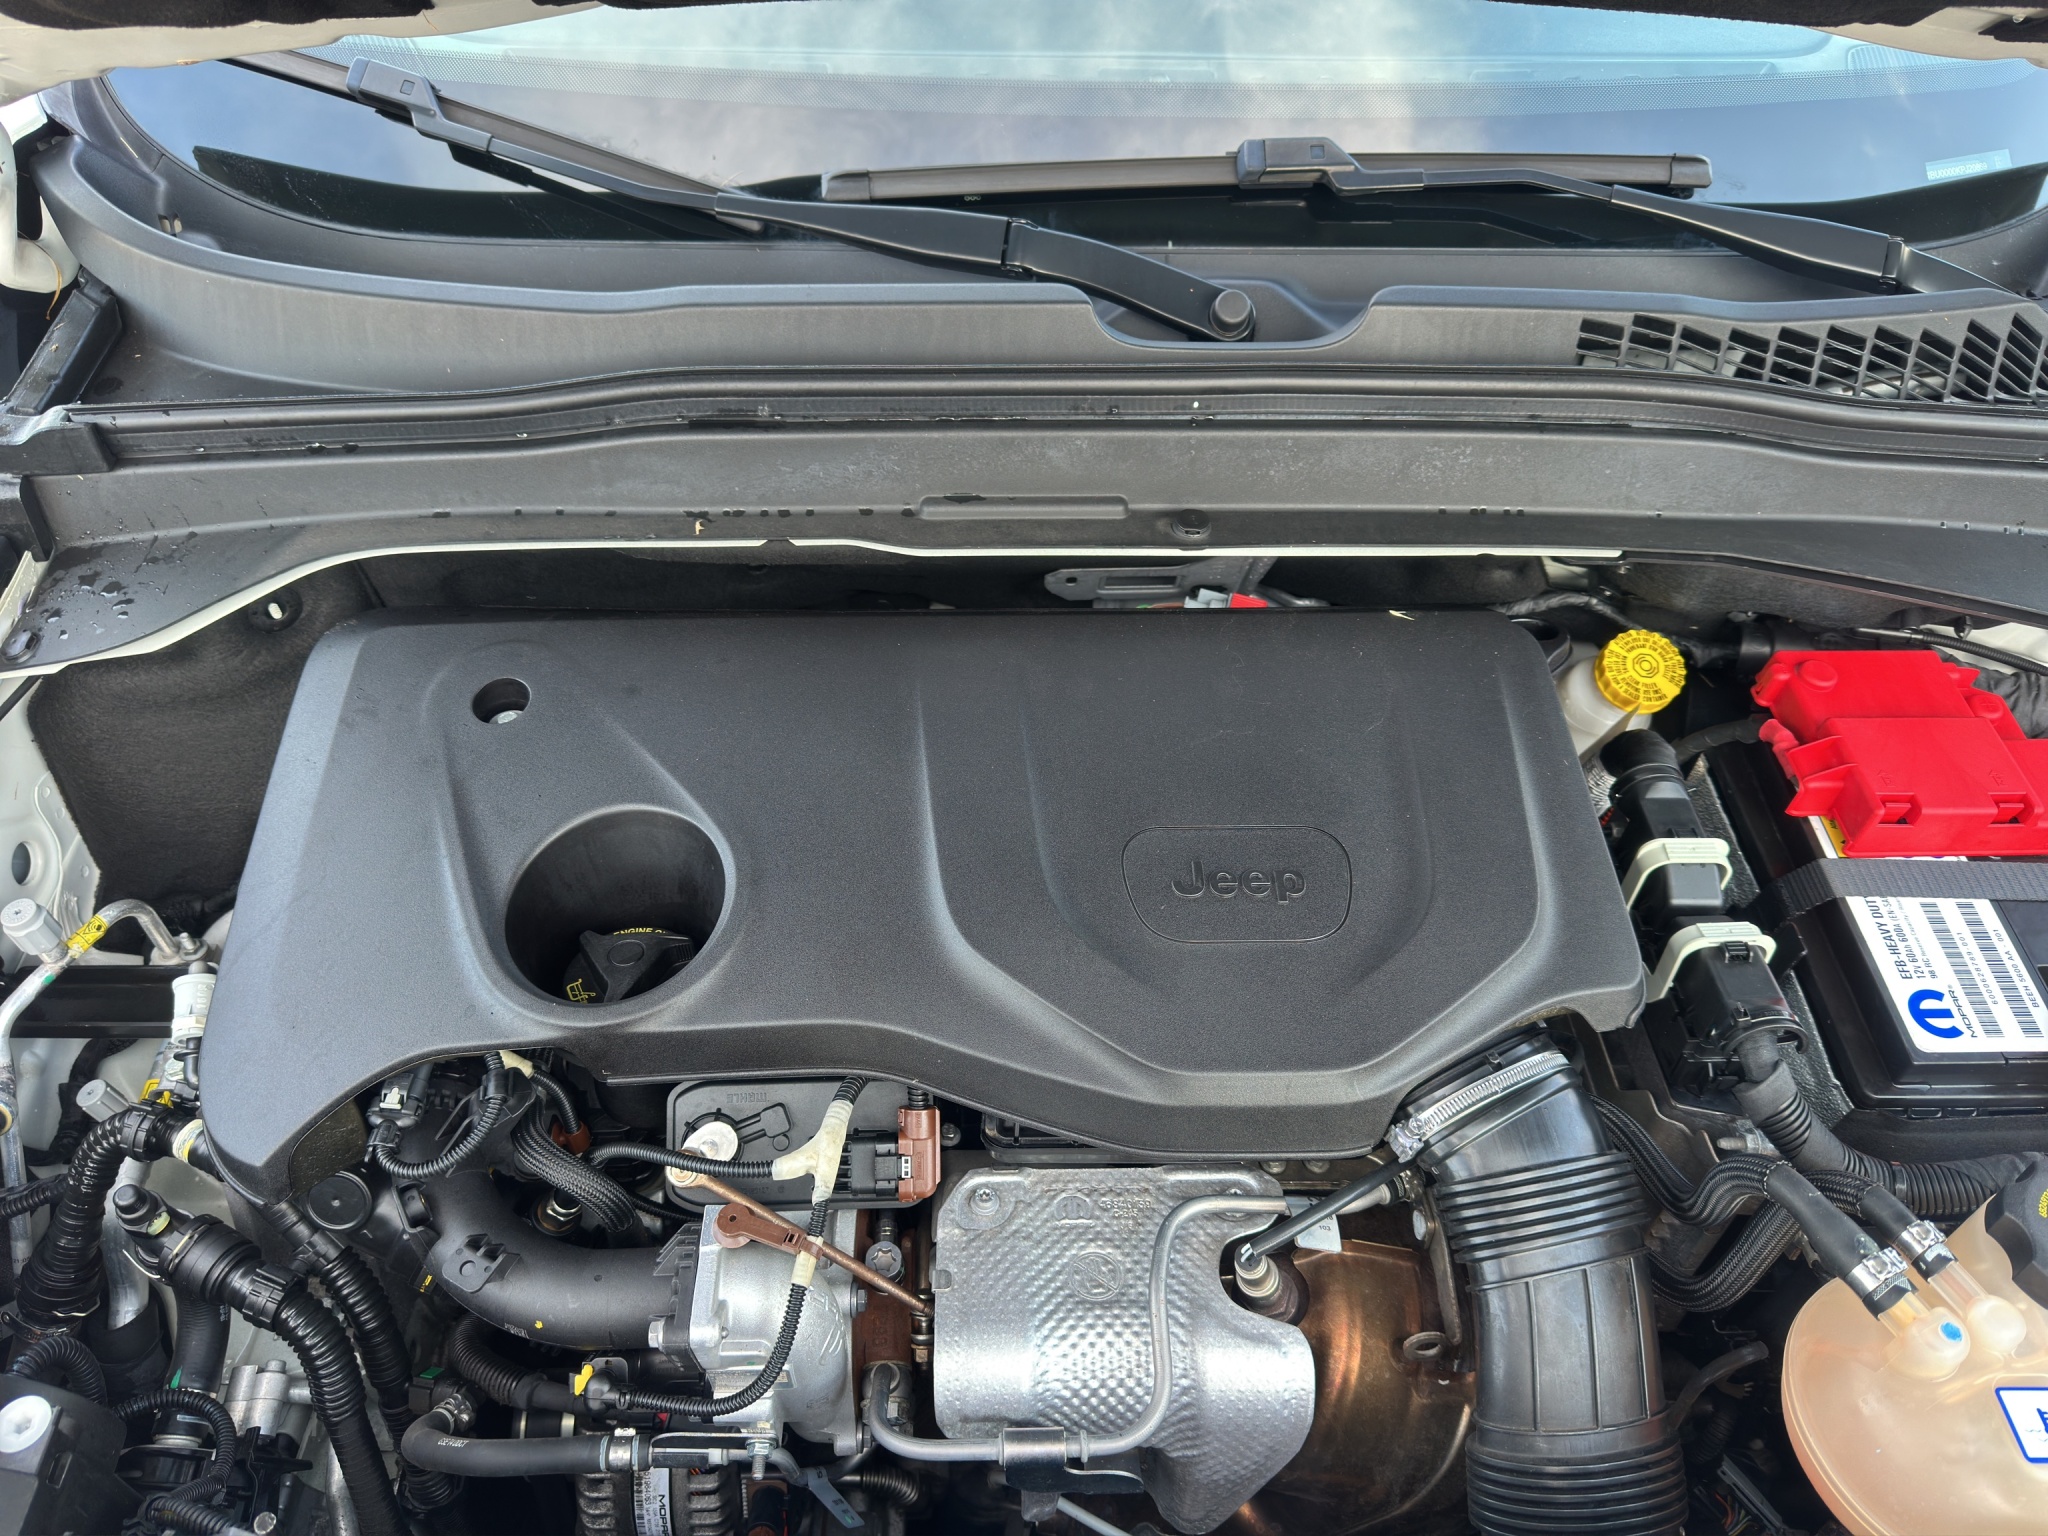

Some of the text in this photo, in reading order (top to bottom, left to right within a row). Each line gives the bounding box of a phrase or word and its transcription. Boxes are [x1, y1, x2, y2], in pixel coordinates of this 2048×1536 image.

[1171, 860, 1306, 905] Jeep
[1875, 921, 1913, 979] EFB-HEAVY
[2012, 964, 2026, 983] 5600
[1948, 990, 1978, 1038] MOPAR
[2023, 985, 2040, 1008] BEEH
